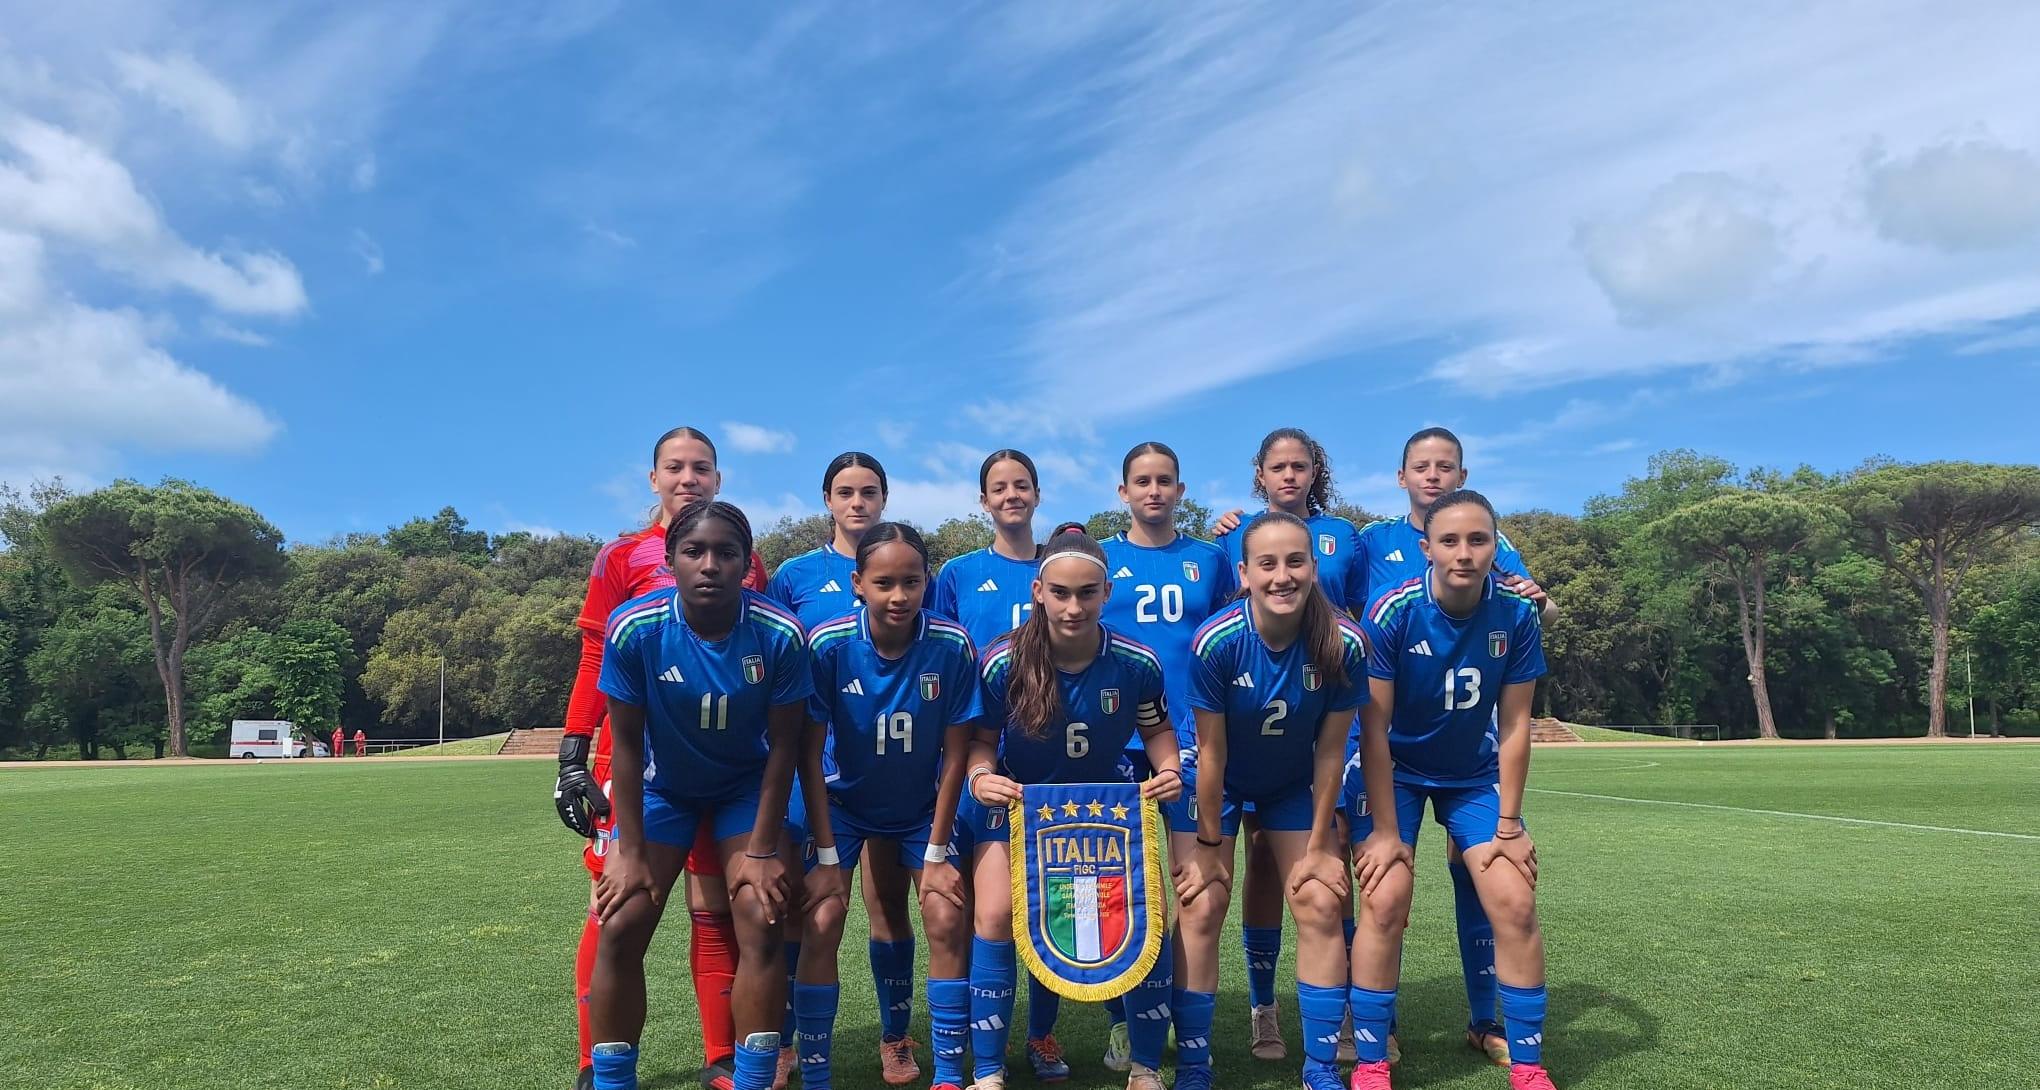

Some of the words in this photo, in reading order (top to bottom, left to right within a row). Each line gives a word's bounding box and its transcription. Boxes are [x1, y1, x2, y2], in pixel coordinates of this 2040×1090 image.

[1012, 603, 1034, 629] 1
[1134, 584, 1184, 623] 20
[744, 657, 761, 665] ITALIA
[1444, 667, 1482, 711] 13
[700, 692, 728, 730] 11
[1260, 699, 1288, 736] 2
[876, 711, 913, 756] 19
[1066, 722, 1090, 759] 6
[1046, 837, 1121, 863] ITALIA
[1073, 864, 1096, 875] FIGC
[1476, 938, 1495, 946] ITA
[884, 978, 913, 987] ITALI
[1140, 975, 1173, 989] TALIA
[798, 1031, 827, 1041] TALIA
